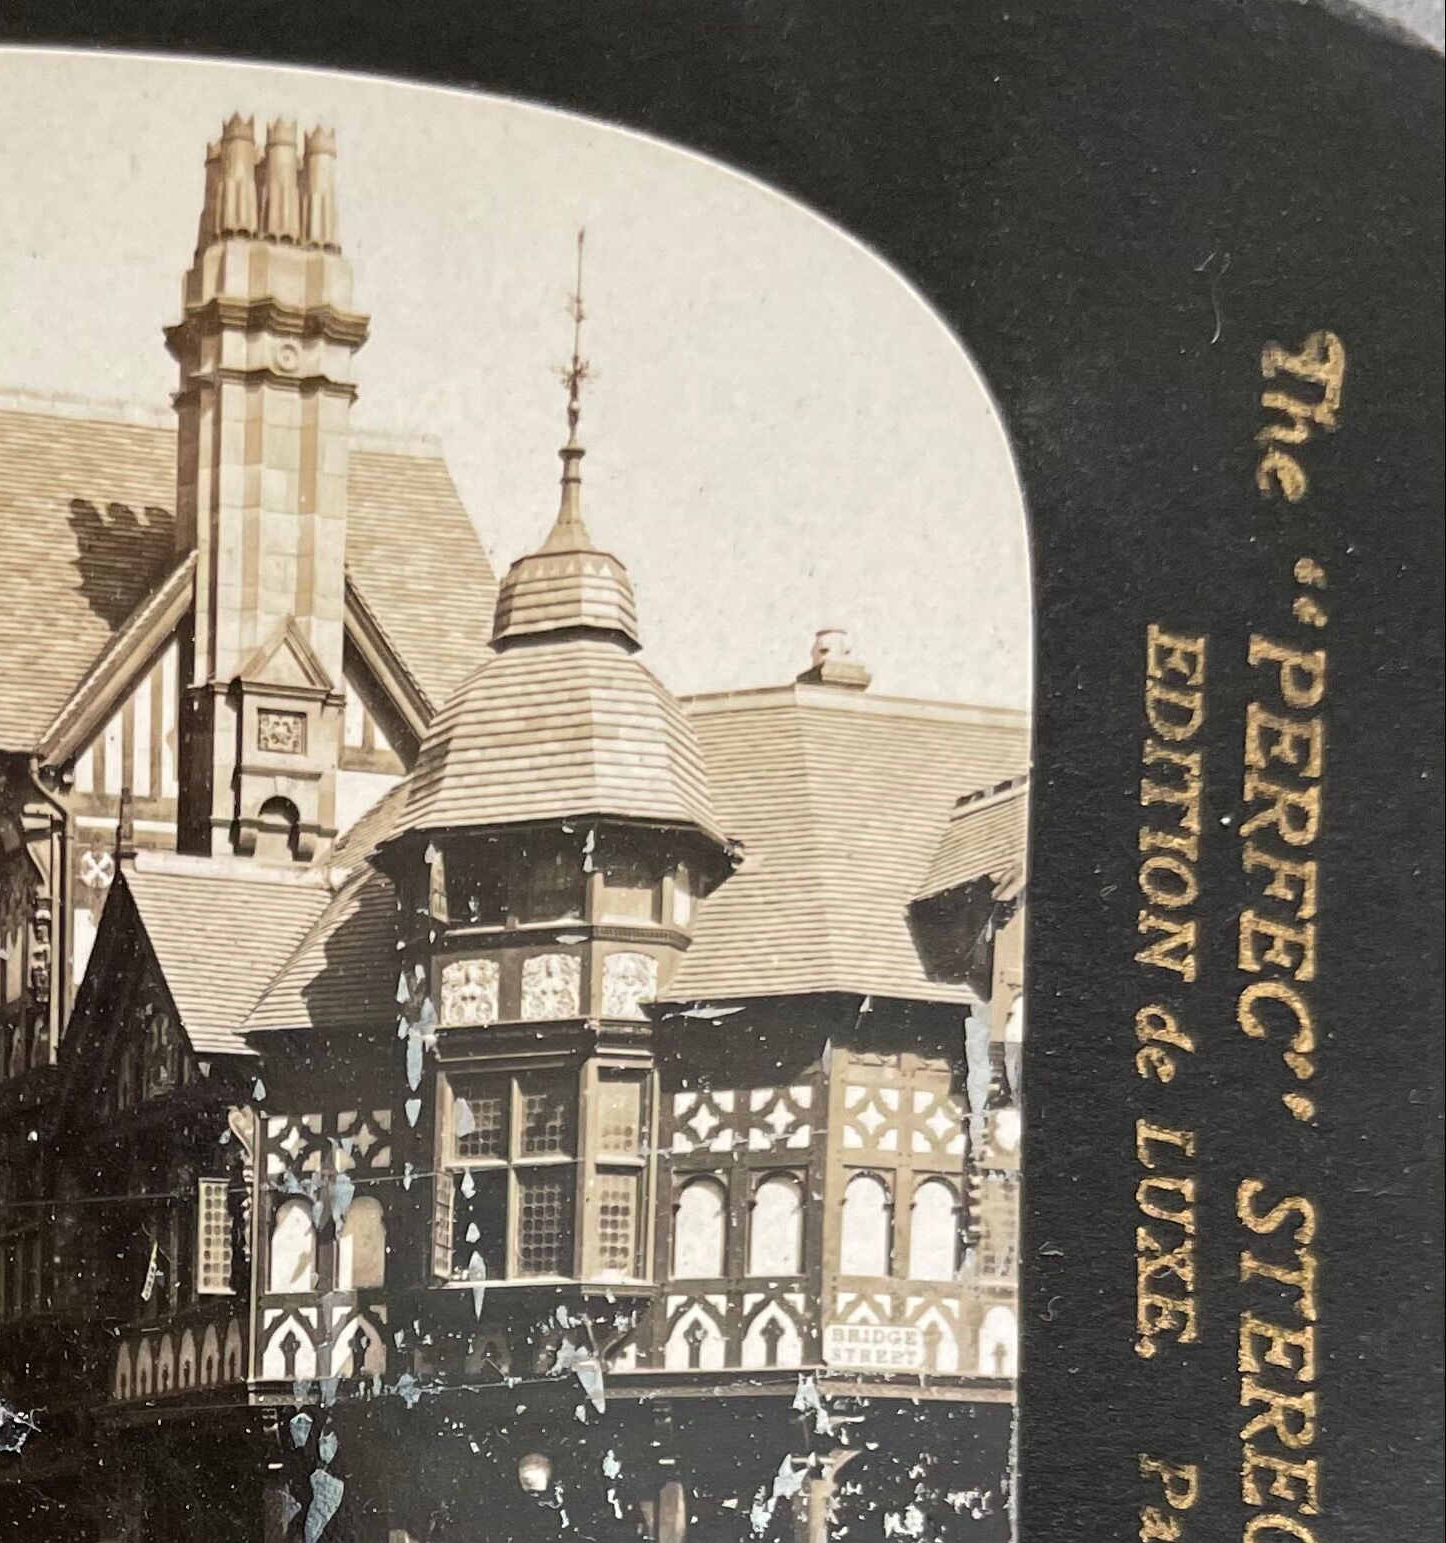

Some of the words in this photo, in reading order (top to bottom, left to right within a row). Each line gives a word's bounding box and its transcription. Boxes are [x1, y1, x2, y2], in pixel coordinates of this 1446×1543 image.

[1257, 331, 1347, 502] The
[1135, 622, 1208, 983] EDITION
[1134, 1003, 1197, 1084] de
[832, 1328, 917, 1346] BRIDGE
[832, 1348, 917, 1365] STREET
